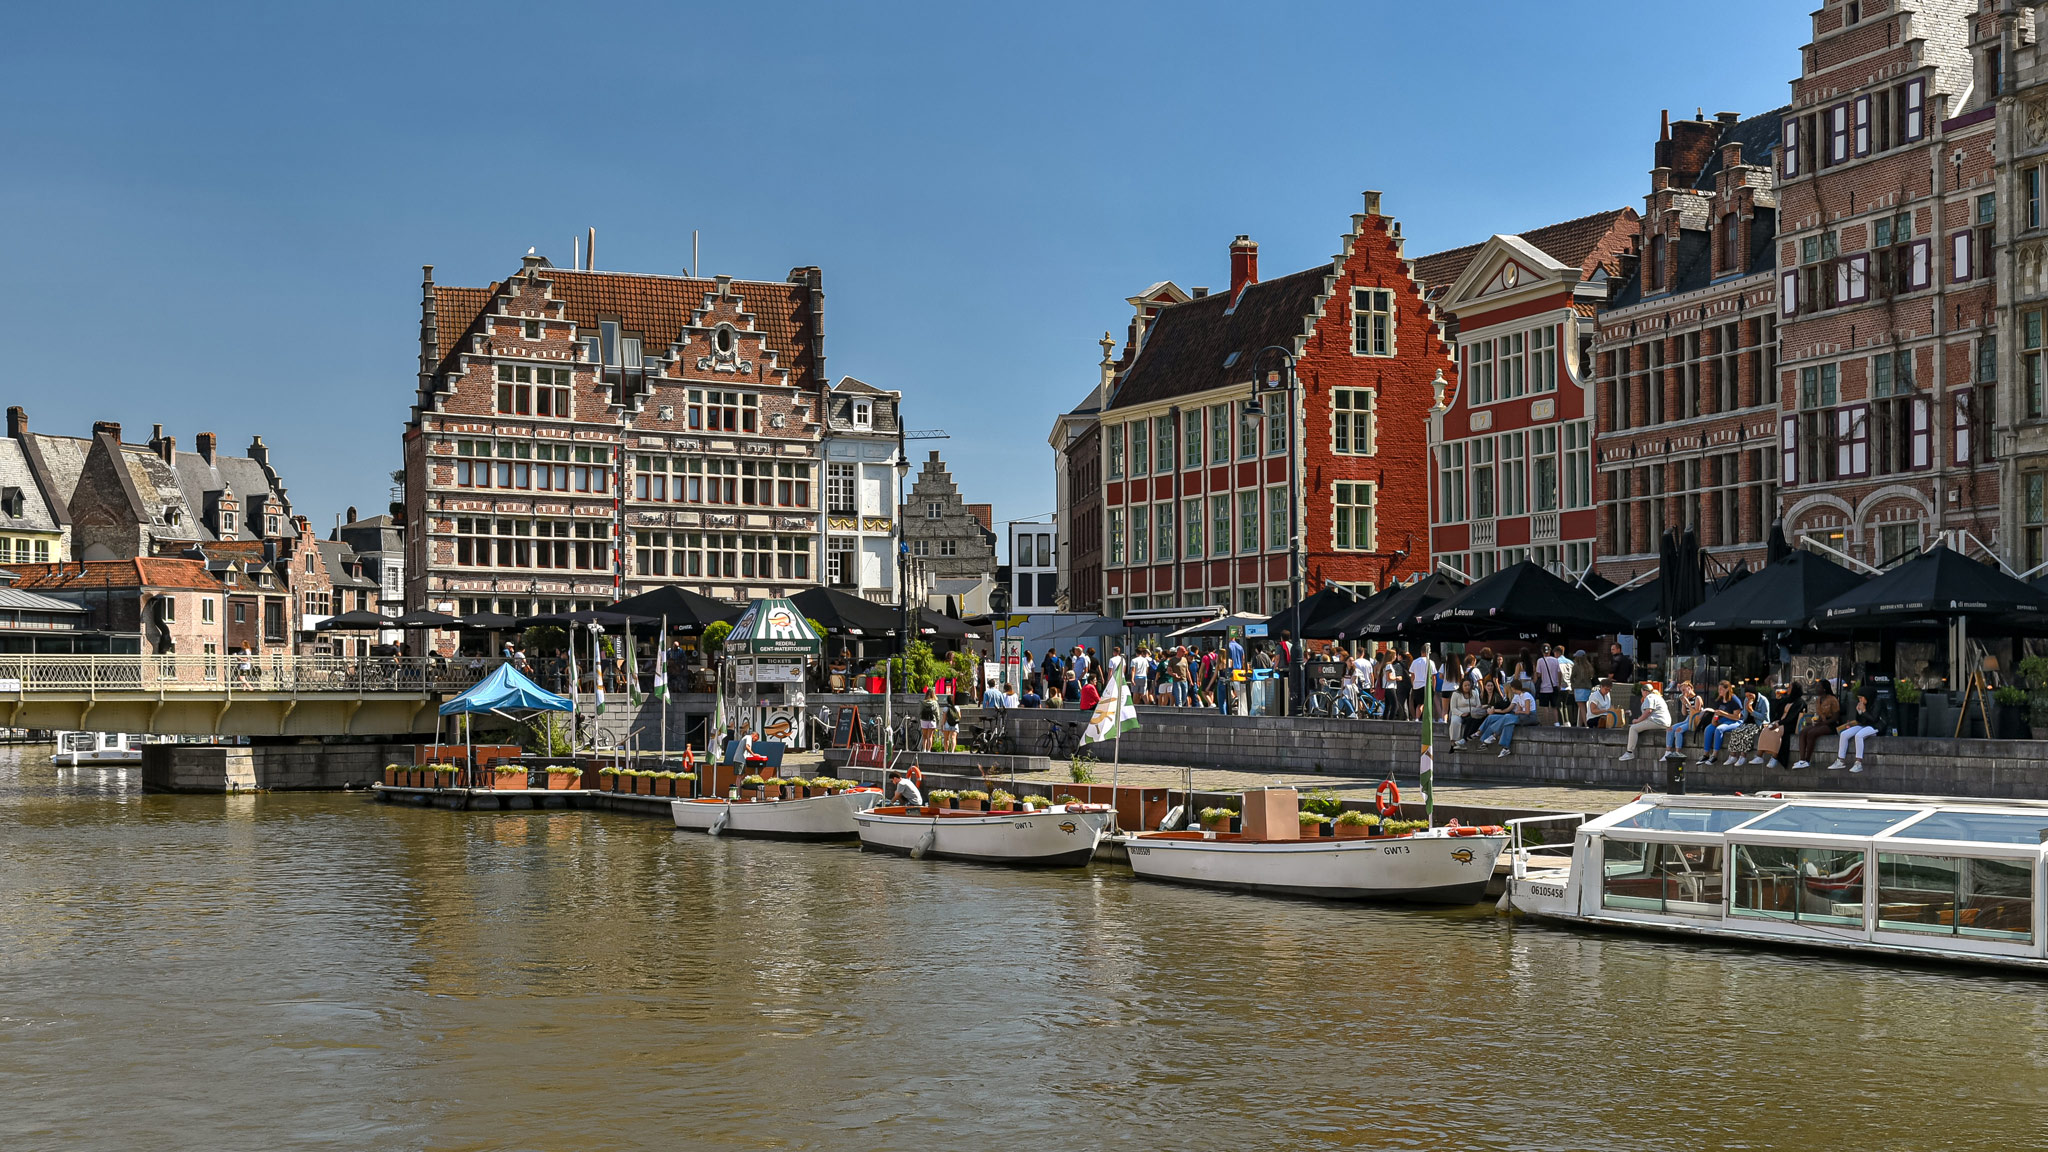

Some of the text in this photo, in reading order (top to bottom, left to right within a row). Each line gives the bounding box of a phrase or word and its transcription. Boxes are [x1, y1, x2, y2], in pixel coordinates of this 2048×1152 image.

[1454, 608, 1475, 616] Leeuw
[726, 642, 747, 652] BOAT TRIP
[1014, 822, 1028, 830] GWT
[1383, 845, 1410, 855] GWT 3
[1531, 885, 1564, 898] 06105458
